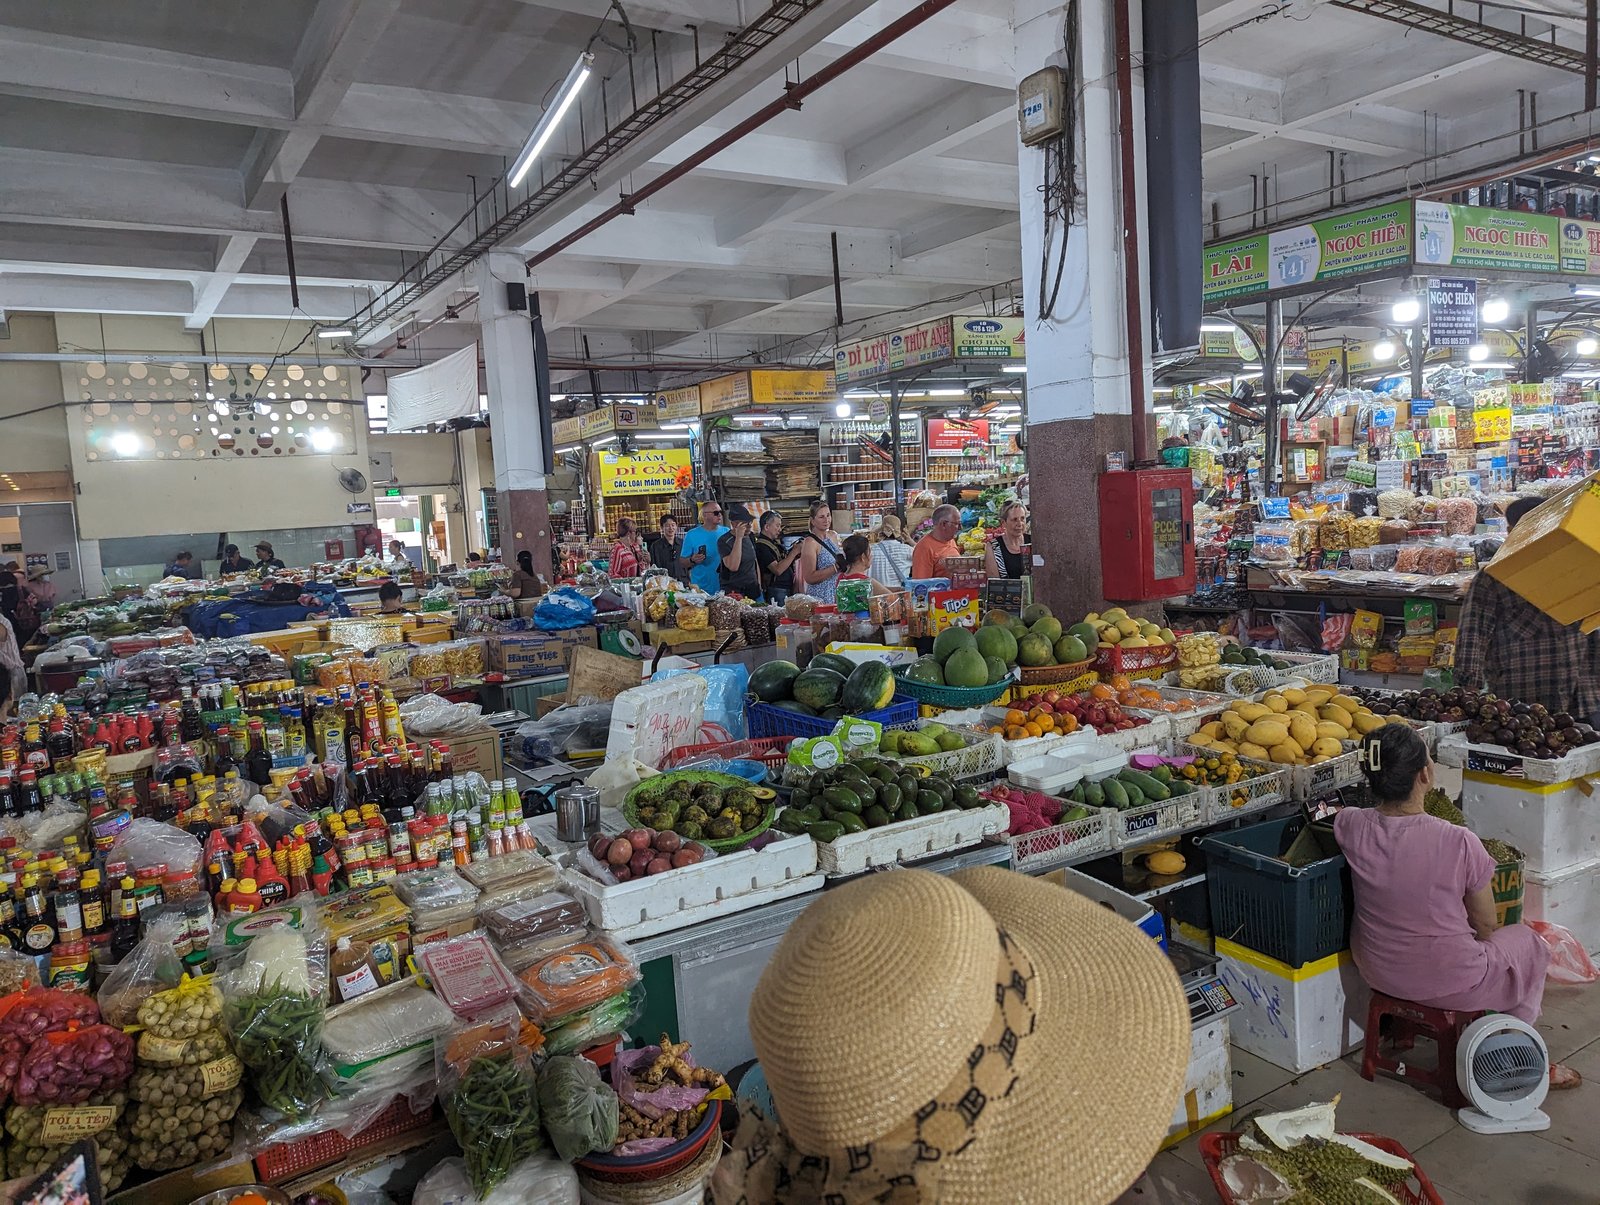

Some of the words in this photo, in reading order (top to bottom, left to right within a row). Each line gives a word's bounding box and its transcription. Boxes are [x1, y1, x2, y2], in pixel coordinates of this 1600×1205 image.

[1326, 233, 1366, 255] NGỌC
[1465, 226, 1510, 247] NGỌC
[1424, 238, 1442, 257] 141
[1211, 255, 1252, 278] LÀI
[1281, 260, 1305, 279] 141
[1430, 291, 1453, 308] NGỌC
[848, 345, 861, 367] DÌ
[615, 465, 637, 476] DÌ
[1154, 521, 1178, 533] PCCC
[942, 597, 969, 613] Tipo
[1484, 760, 1506, 770] Icon
[1129, 815, 1154, 831] nuna
[258, 885, 284, 896] CHIN-SU
